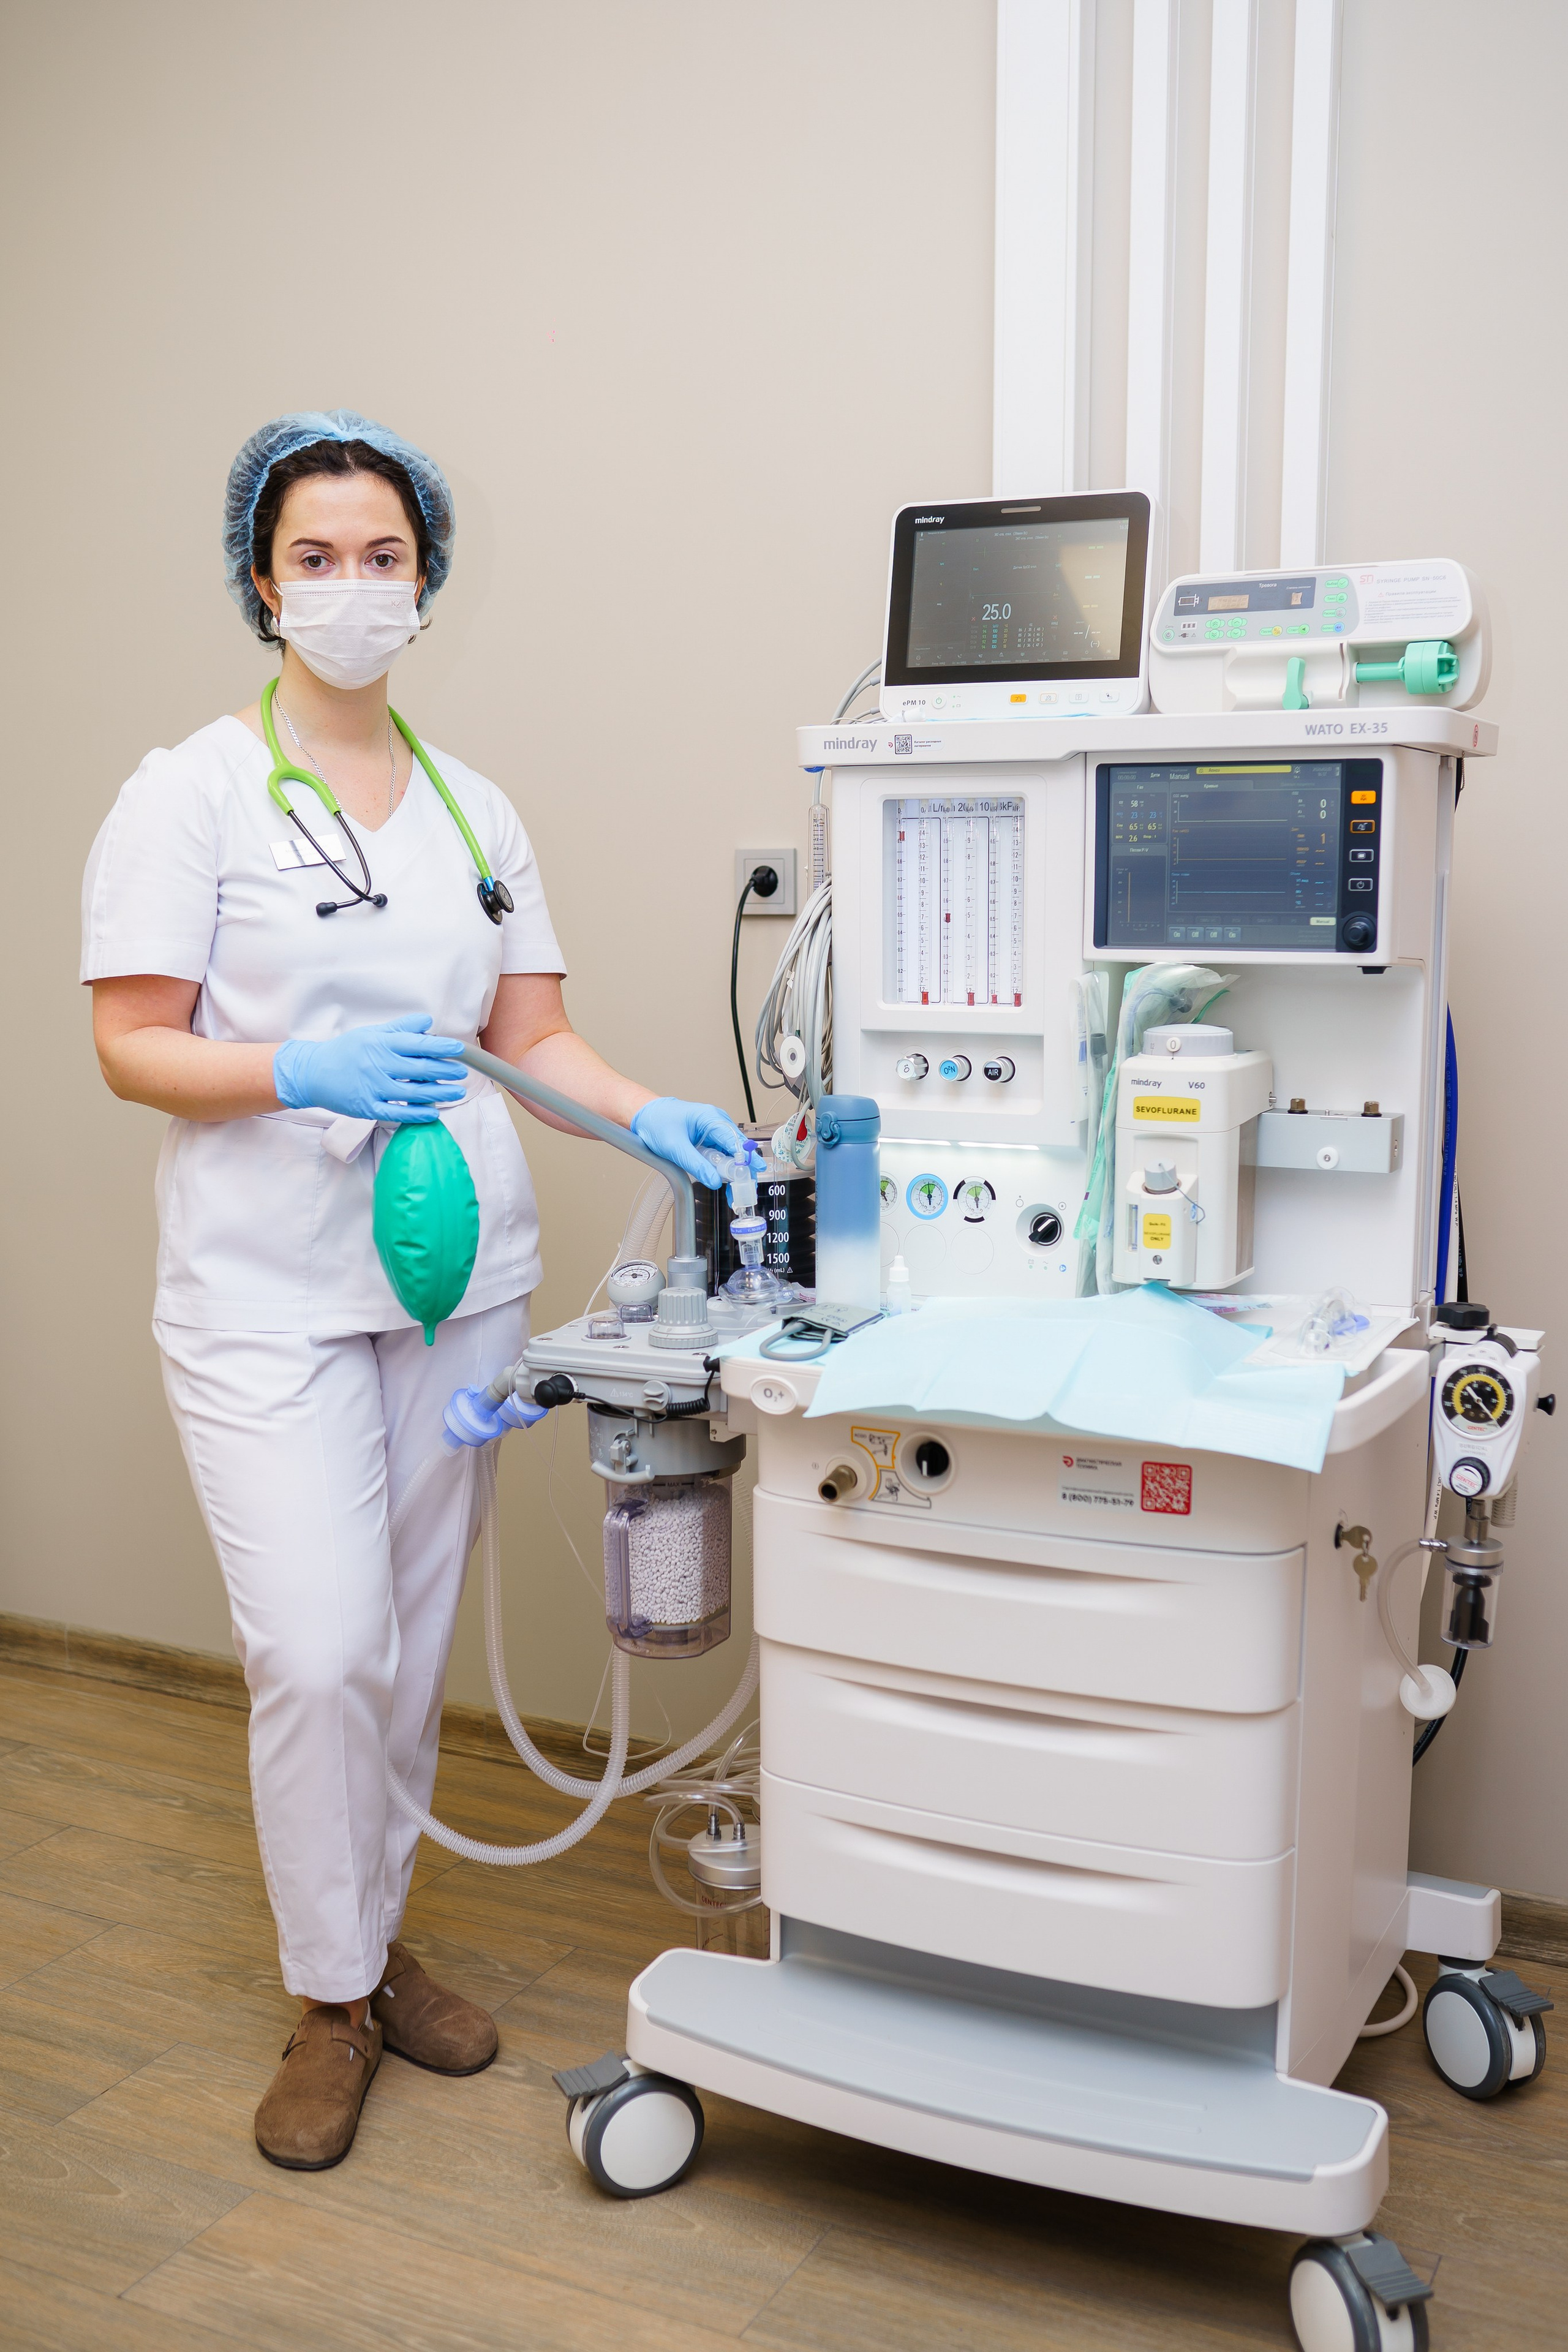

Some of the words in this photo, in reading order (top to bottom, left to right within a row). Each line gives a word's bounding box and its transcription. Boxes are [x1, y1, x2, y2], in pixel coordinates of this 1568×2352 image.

[982, 603, 1012, 620] 25.0
[1305, 723, 1344, 736] WATO
[1350, 722, 1389, 734] EX-35
[823, 737, 878, 753] mindray
[1319, 799, 1327, 809] 0
[1319, 809, 1327, 820] 0
[943, 1065, 956, 1074] N2O
[1131, 1077, 1162, 1088] mindray
[1188, 1081, 1205, 1090] V60
[1136, 1106, 1197, 1116] SEVOFLURANE
[768, 1185, 785, 1196] 600
[769, 1209, 786, 1221] 900
[766, 1232, 790, 1243] 1200
[767, 1253, 790, 1264] 1500
[1460, 1443, 1488, 1452] SURGICAL
[1455, 1473, 1478, 1488] GENTEC
[1061, 1491, 1067, 1500] 8
[1068, 1493, 1092, 1504] (800)
